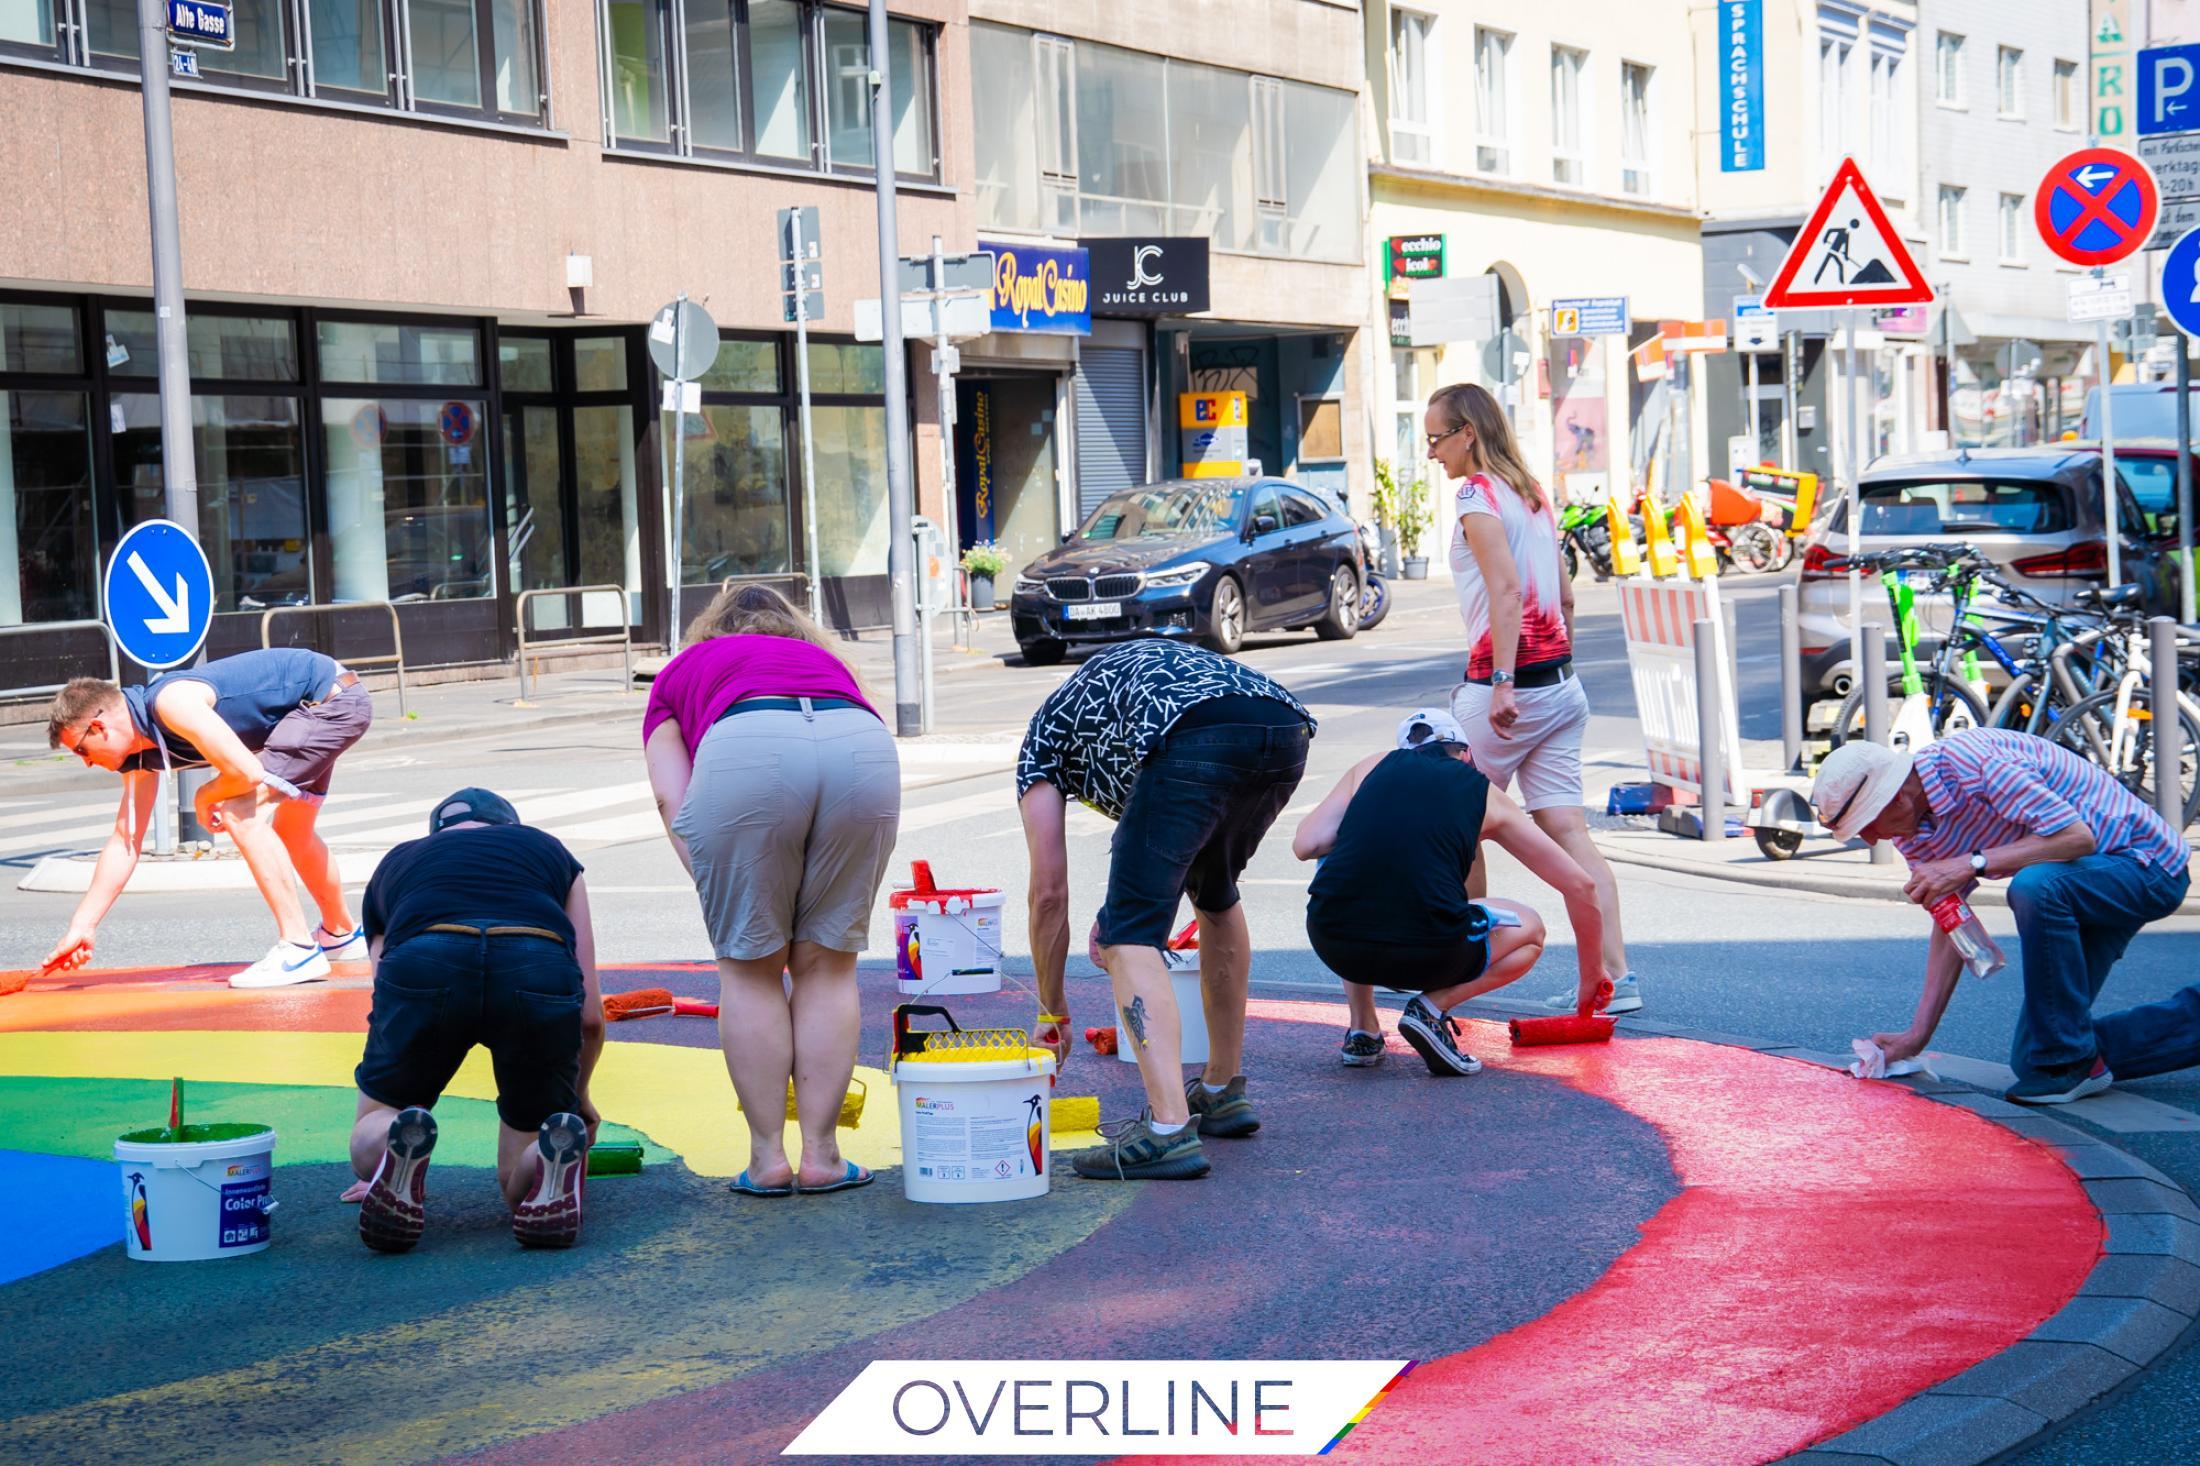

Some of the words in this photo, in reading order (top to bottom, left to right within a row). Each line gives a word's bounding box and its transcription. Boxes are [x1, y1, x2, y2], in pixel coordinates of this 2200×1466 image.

[175, 3, 195, 29] Alte
[197, 7, 225, 34] Gasse
[1730, 3, 1749, 168] SPRACHSCHULE
[2154, 56, 2194, 123] P
[996, 251, 1042, 328] Royal
[1042, 259, 1087, 317] Casino
[1102, 293, 1146, 304] JUICE
[1152, 291, 1188, 303] CLUB
[225, 1197, 256, 1211] Color
